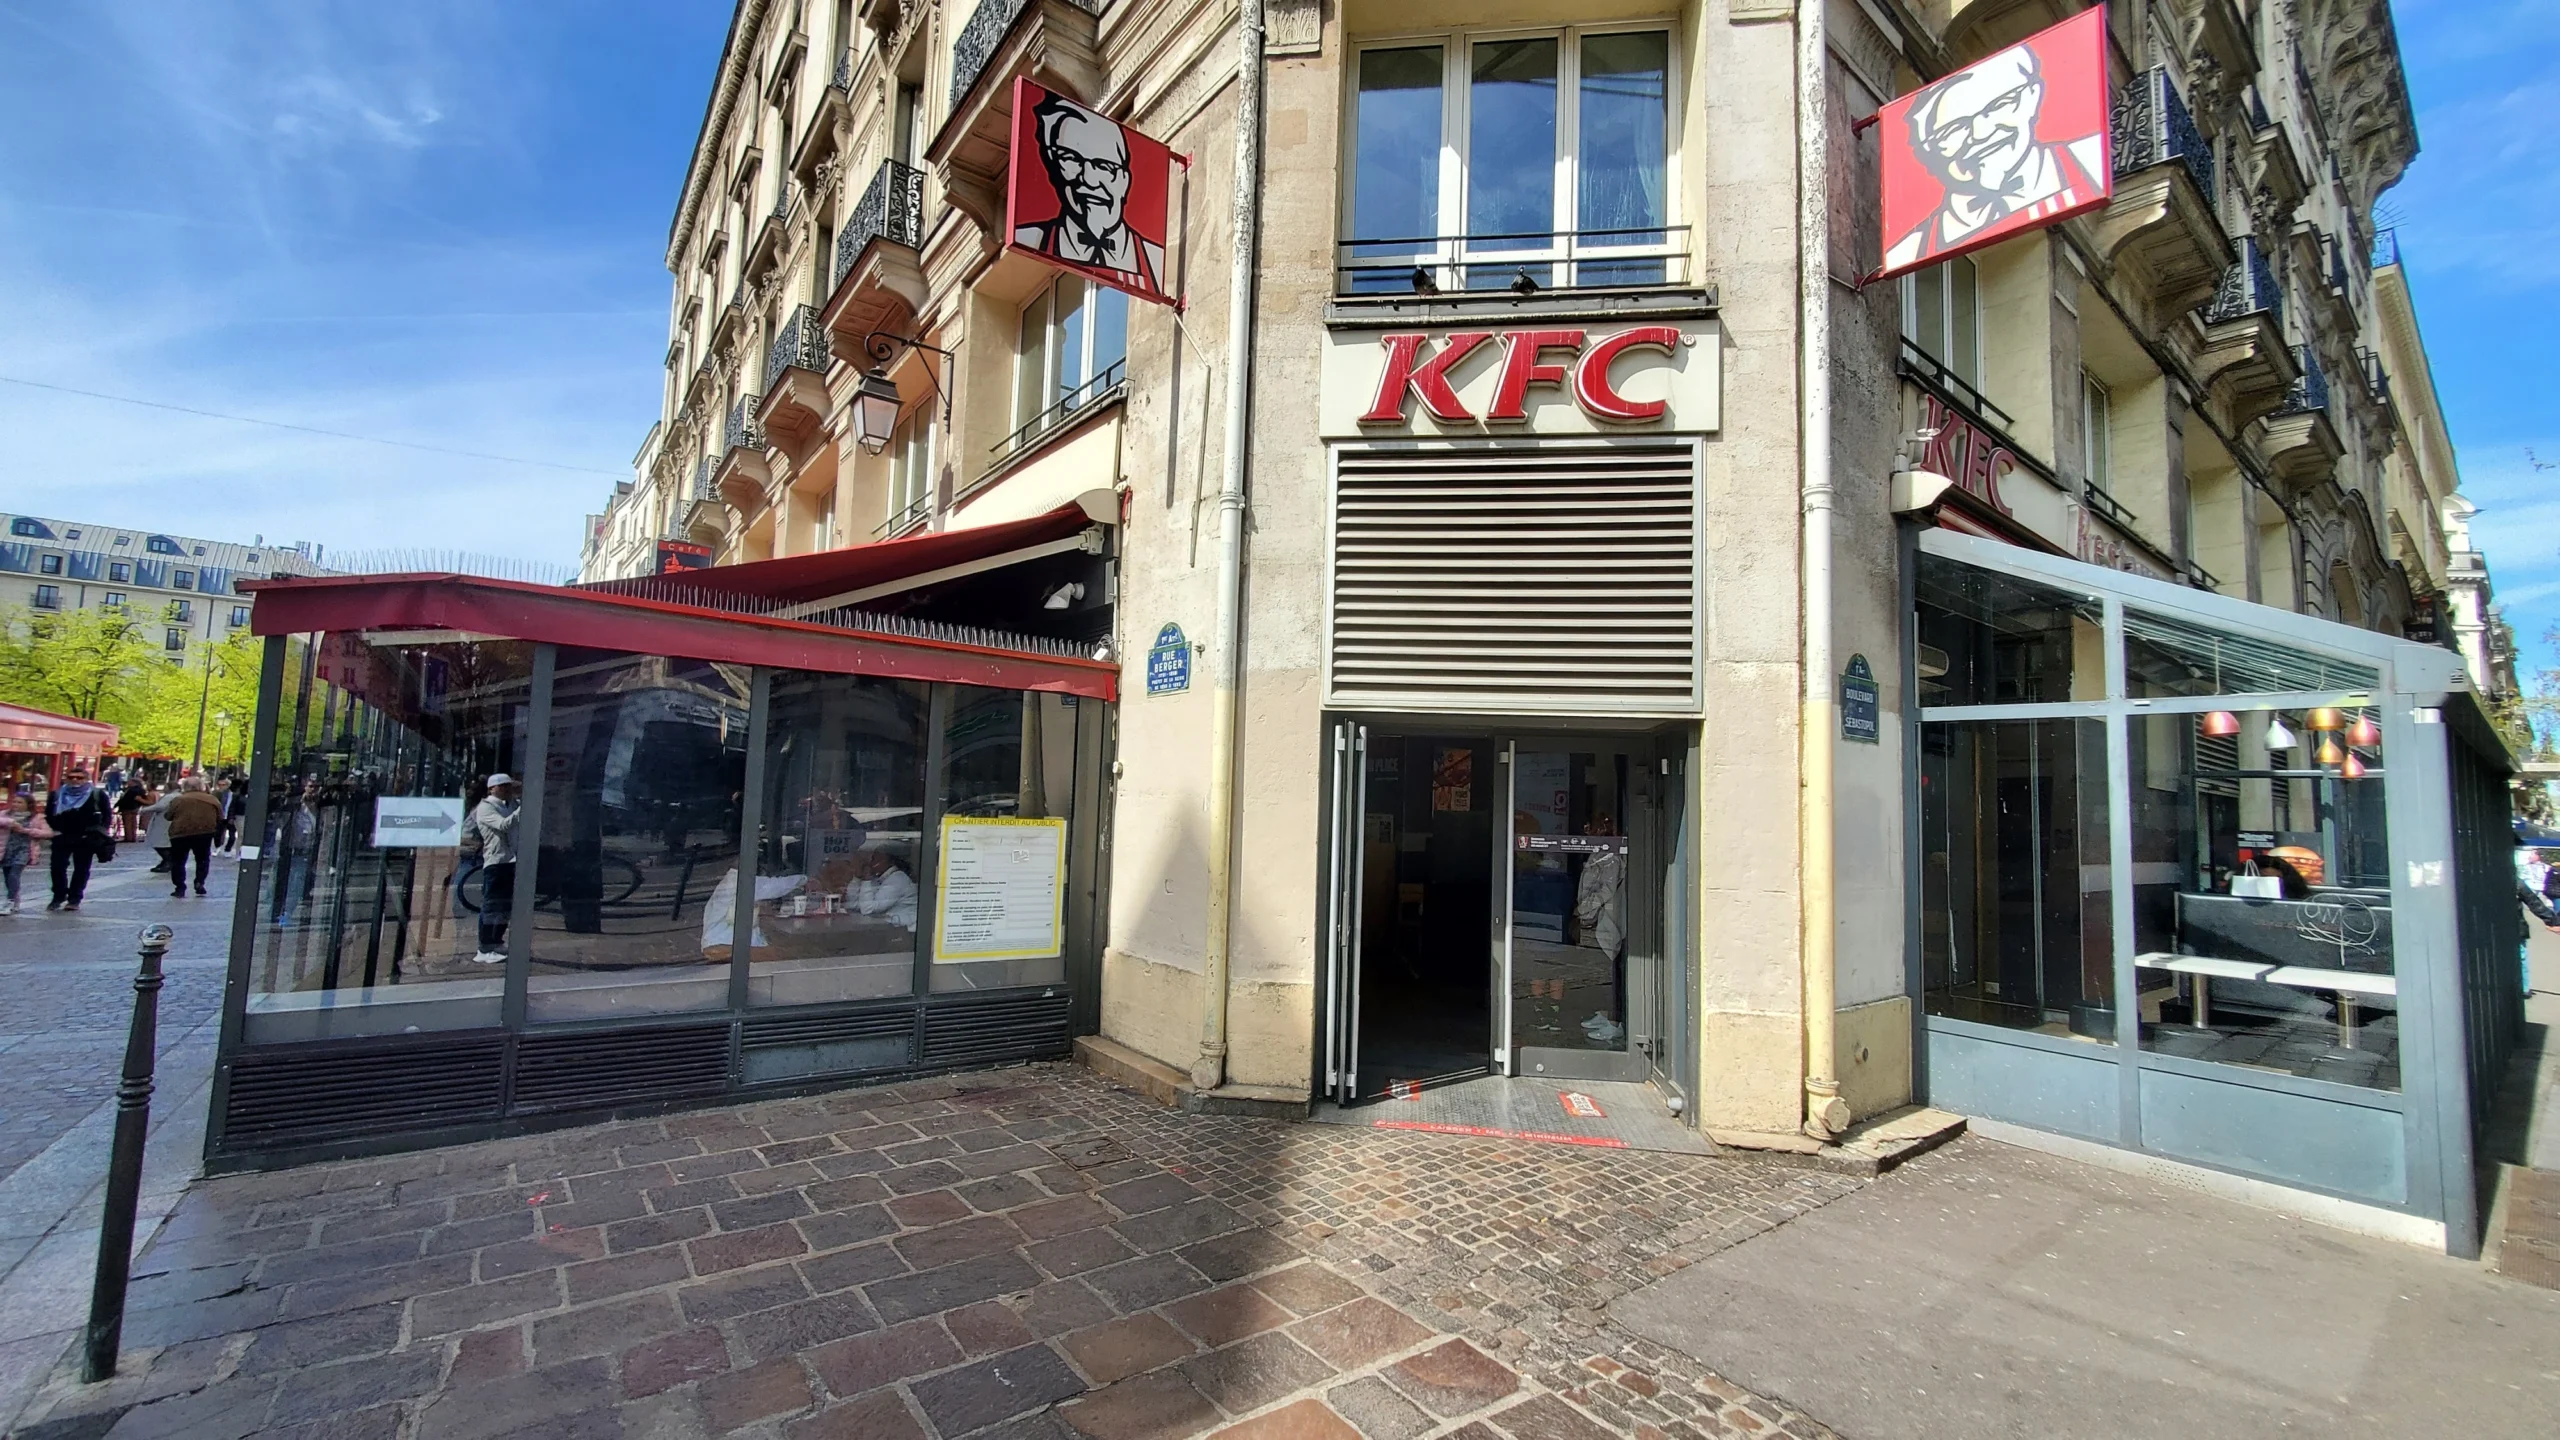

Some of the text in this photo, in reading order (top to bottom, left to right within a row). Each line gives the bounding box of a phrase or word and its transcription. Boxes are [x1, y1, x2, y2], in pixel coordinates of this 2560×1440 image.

[1356, 327, 1682, 425] KFC
[1918, 393, 2016, 518] KFC
[1162, 650, 1175, 661] RUE
[1154, 659, 1182, 672] BERGER
[954, 817, 988, 825] CHANTIER
[989, 818, 1019, 826] INTERDIT
[1032, 819, 1056, 827] PUBLIC
